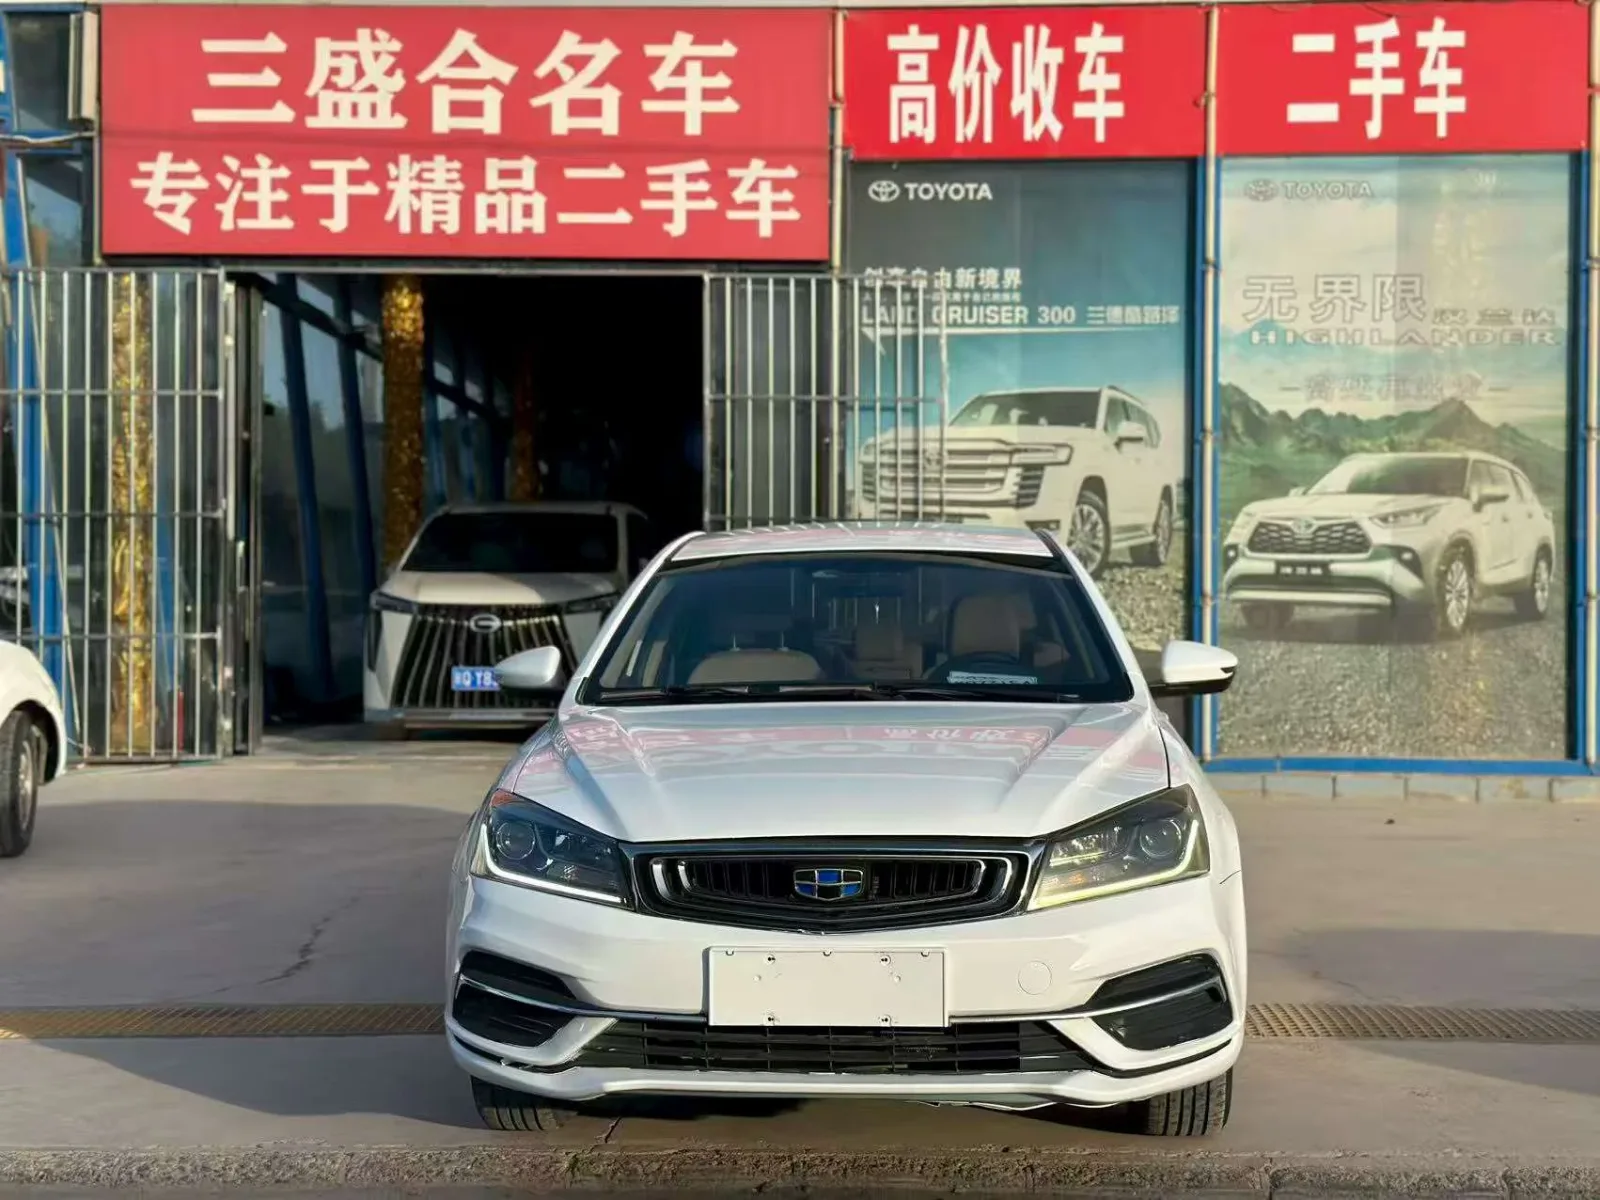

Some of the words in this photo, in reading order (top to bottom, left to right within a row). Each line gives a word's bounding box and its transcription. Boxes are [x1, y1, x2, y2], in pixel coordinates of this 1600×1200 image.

[191, 28, 741, 136] 三盛合名车
[886, 22, 1125, 143] 高价收车
[1286, 16, 1467, 140] 二手车
[129, 150, 802, 238] 专注于精品二手车
[904, 182, 993, 201] TOYOTA
[1283, 180, 1373, 200] TOYOTA
[931, 305, 1029, 325] CRUISER
[1037, 305, 1076, 325] 300
[1242, 273, 1427, 324] 无界限
[1249, 327, 1562, 347] HIGHLANDER
